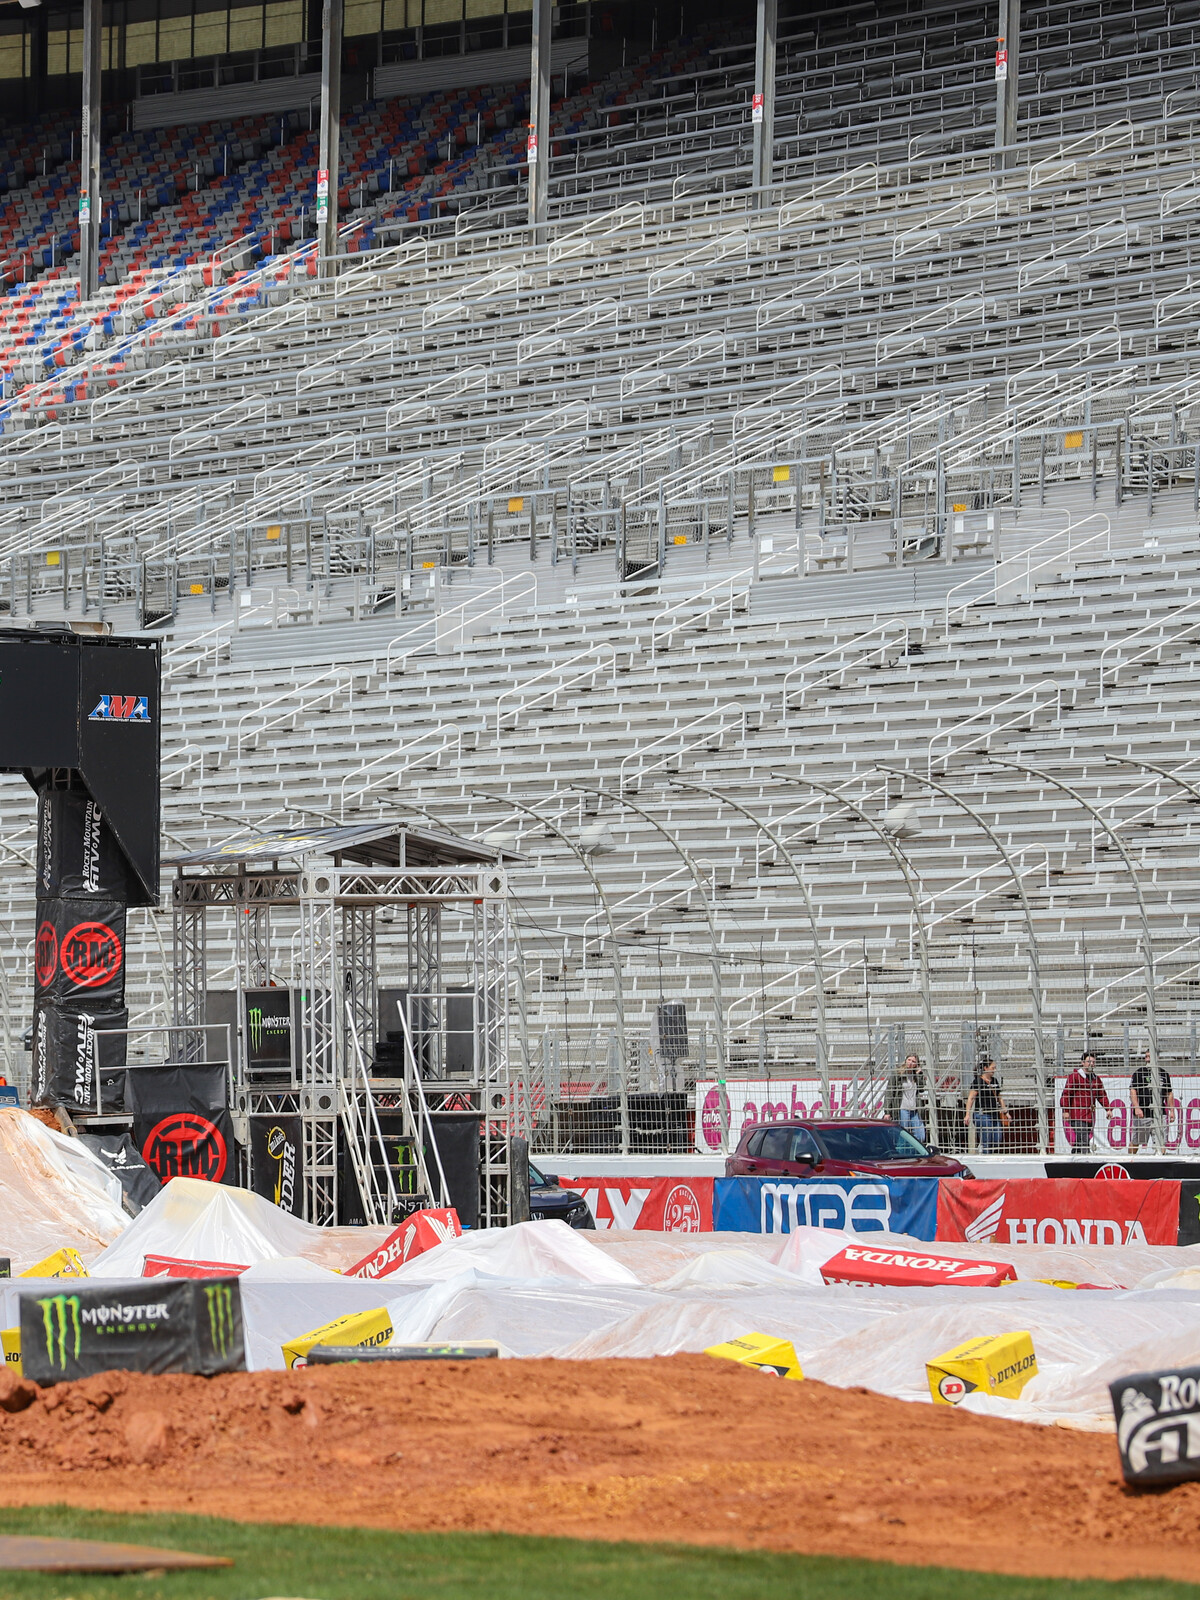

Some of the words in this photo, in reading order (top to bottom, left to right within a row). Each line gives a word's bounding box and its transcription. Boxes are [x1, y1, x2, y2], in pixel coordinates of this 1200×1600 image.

[88, 695, 151, 719] AMA
[83, 800, 93, 848] MOUNTAIN
[82, 849, 90, 877] ROCKY
[86, 1027, 94, 1058] ROCKY
[84, 1058, 93, 1105] MOUNTAIN
[349, 1217, 363, 1225] AMA
[1006, 1218, 1148, 1245] HONDA
[845, 1248, 965, 1272] HONDA
[81, 1303, 170, 1325] MONSTER
[96, 1322, 157, 1335] ENERGY
[997, 1353, 1036, 1384] DUNLOP
